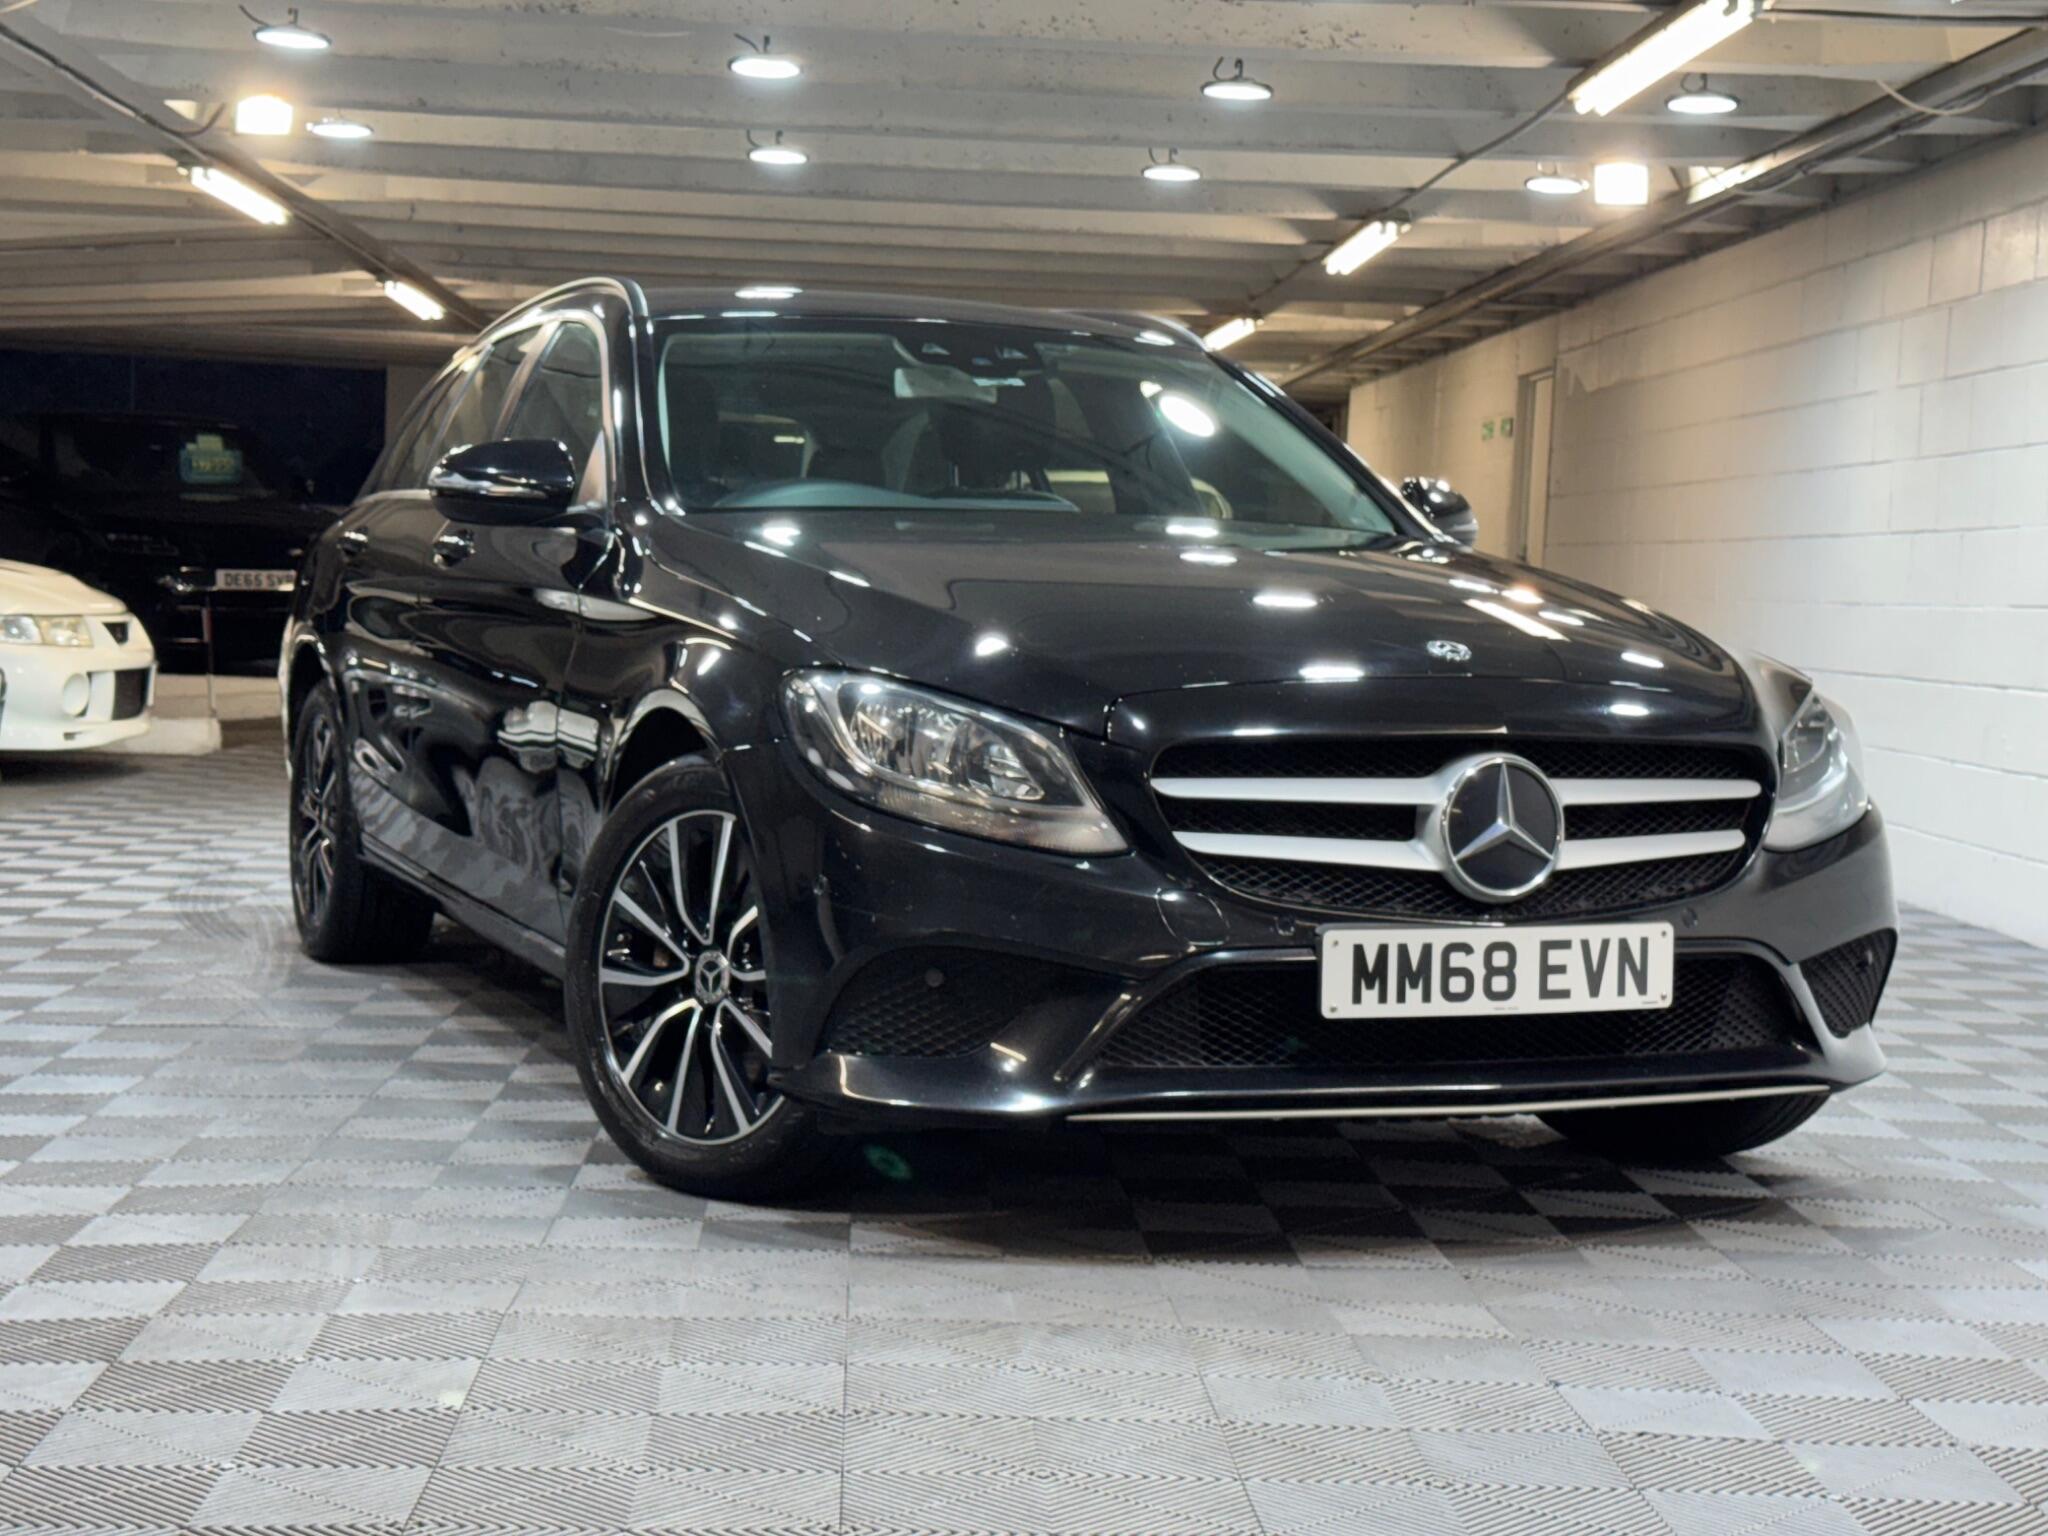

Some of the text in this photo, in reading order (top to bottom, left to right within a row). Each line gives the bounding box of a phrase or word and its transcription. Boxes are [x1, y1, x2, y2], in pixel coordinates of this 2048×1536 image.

[224, 572, 262, 587] DE65
[1351, 936, 1650, 1005] MM68 EVN
